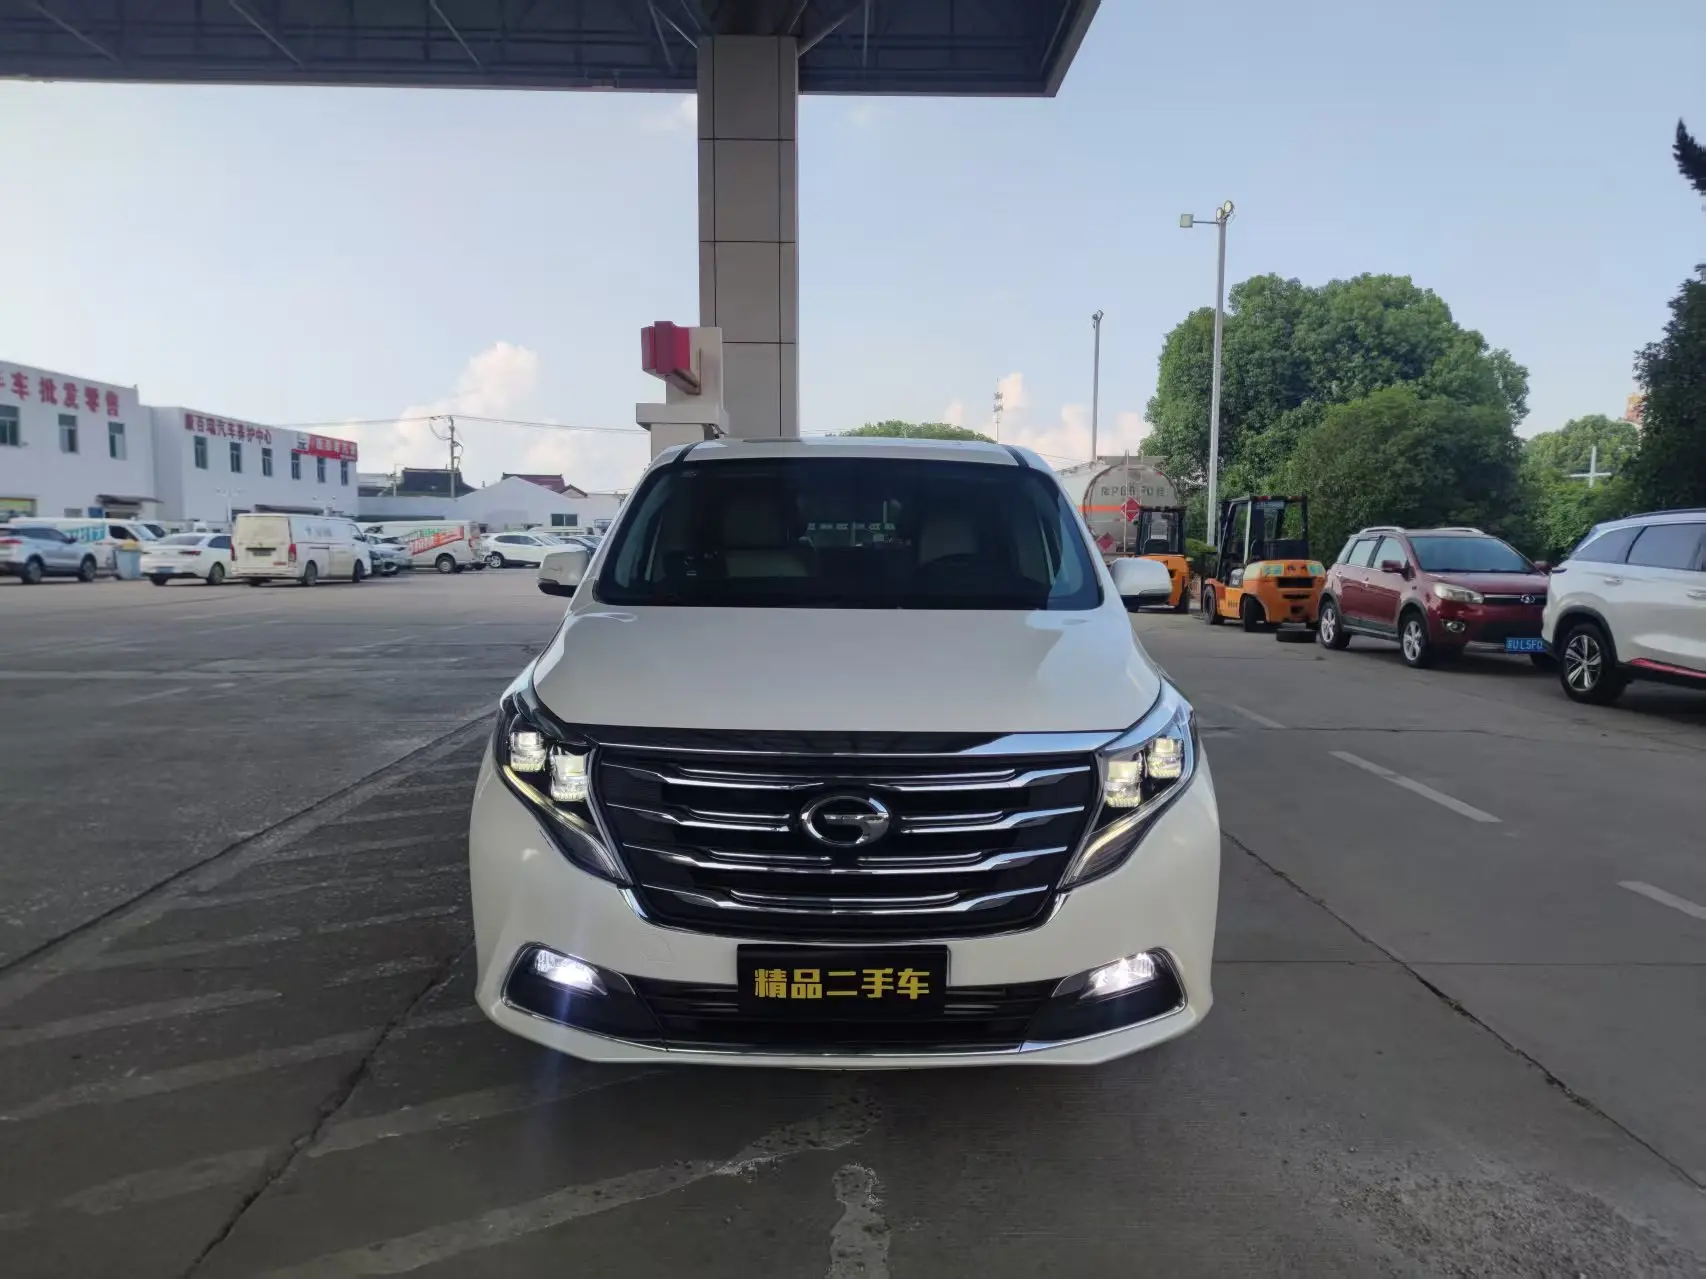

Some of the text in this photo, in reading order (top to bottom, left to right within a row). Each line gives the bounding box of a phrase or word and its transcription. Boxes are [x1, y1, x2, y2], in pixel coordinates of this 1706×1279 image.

[755, 967, 930, 1000] 精品二手车
